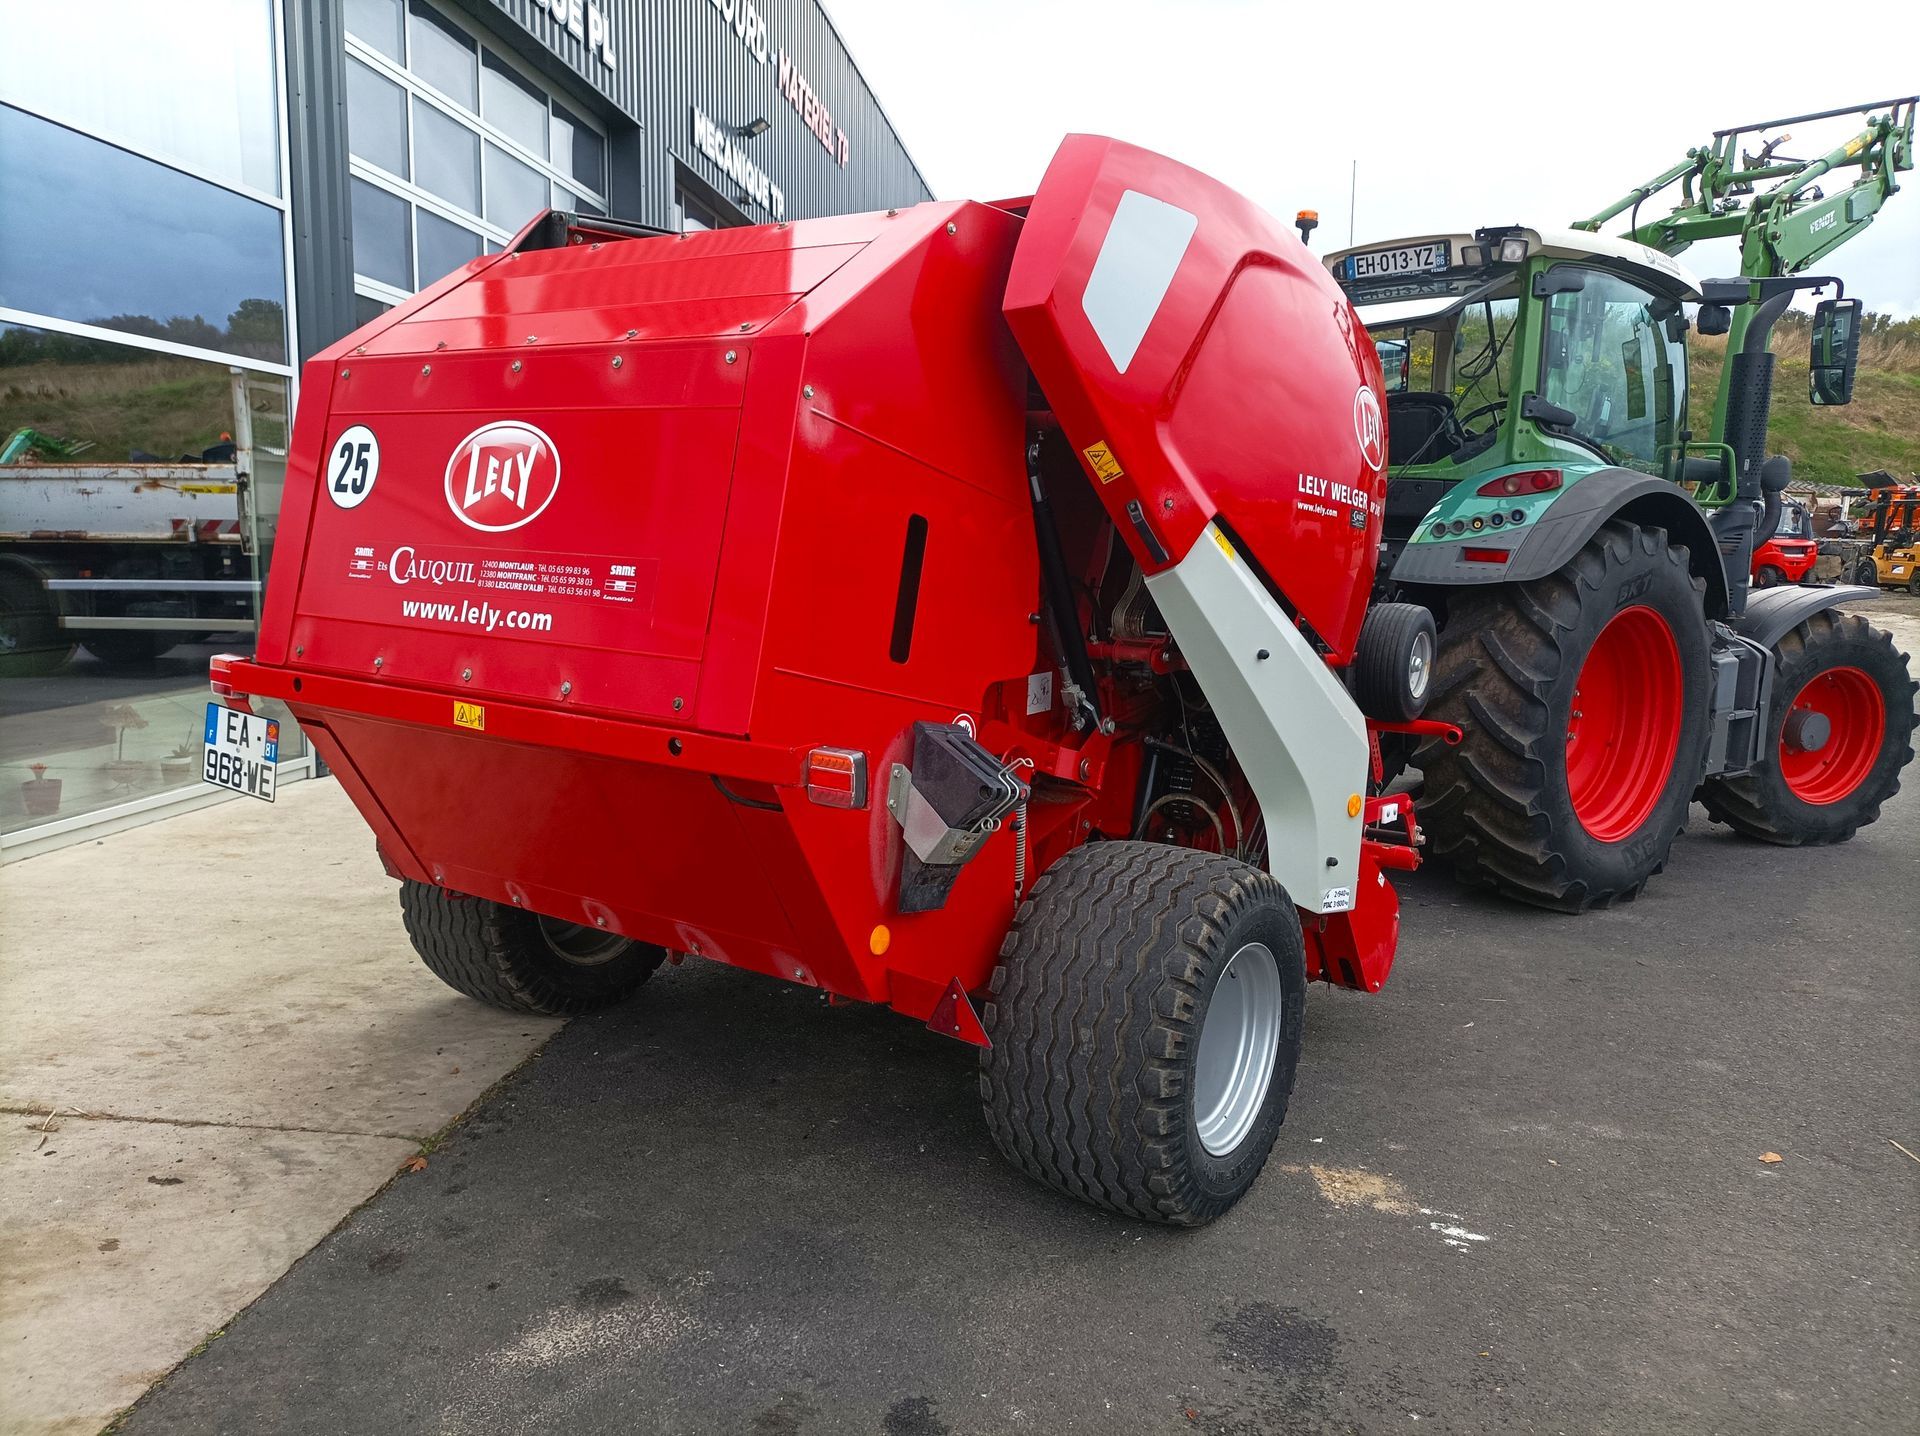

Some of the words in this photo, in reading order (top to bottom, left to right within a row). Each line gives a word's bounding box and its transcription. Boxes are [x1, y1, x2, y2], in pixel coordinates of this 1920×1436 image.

[534, 0, 584, 43] UE
[588, 0, 616, 71] PL
[712, 0, 767, 64] OURD
[778, 48, 835, 156] MATERIEL
[836, 127, 849, 169] TP
[694, 107, 770, 213] MECANIQUE
[770, 184, 784, 221] TP
[1356, 247, 1434, 275] EH-013-YZ
[333, 441, 371, 494] 25
[462, 441, 540, 511] LELY
[1298, 473, 1328, 497] LELY
[1331, 481, 1368, 510] WELGER
[1297, 501, 1338, 518] www.lely.com
[482, 560, 499, 569] 12400
[498, 561, 534, 571] MONTLAUR
[548, 565, 556, 573] 05
[556, 565, 565, 574] 65
[565, 566, 573, 574] 99
[582, 567, 590, 575] 96
[496, 571, 537, 581] MONTFRANC
[551, 575, 558, 584] 05
[559, 576, 567, 585] 65
[567, 577, 576, 585] 99
[610, 565, 637, 577] SAME
[495, 580, 522, 591] LESCURE
[558, 586, 566, 595] 05
[566, 587, 574, 595] 63
[583, 588, 591, 597] 61
[402, 598, 553, 632] www.lely.com
[265, 742, 275, 758] 81
[206, 748, 273, 798] 968-WE
